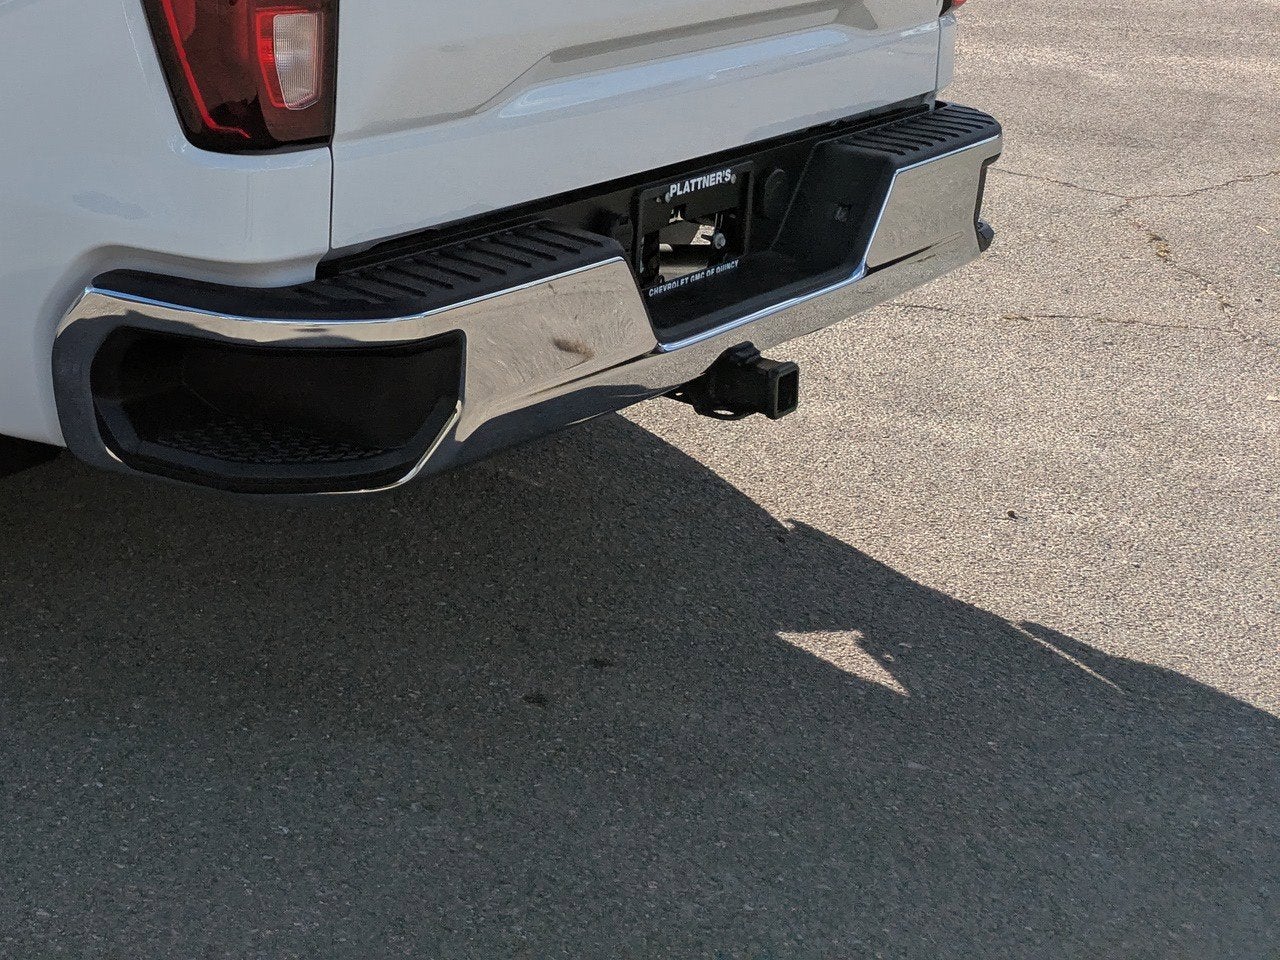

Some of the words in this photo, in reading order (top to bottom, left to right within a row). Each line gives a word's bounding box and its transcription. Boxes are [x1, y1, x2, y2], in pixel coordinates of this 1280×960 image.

[669, 168, 732, 198] PLATTNER'S
[648, 276, 690, 297] CHEVROLET
[715, 259, 740, 274] QUINCY
